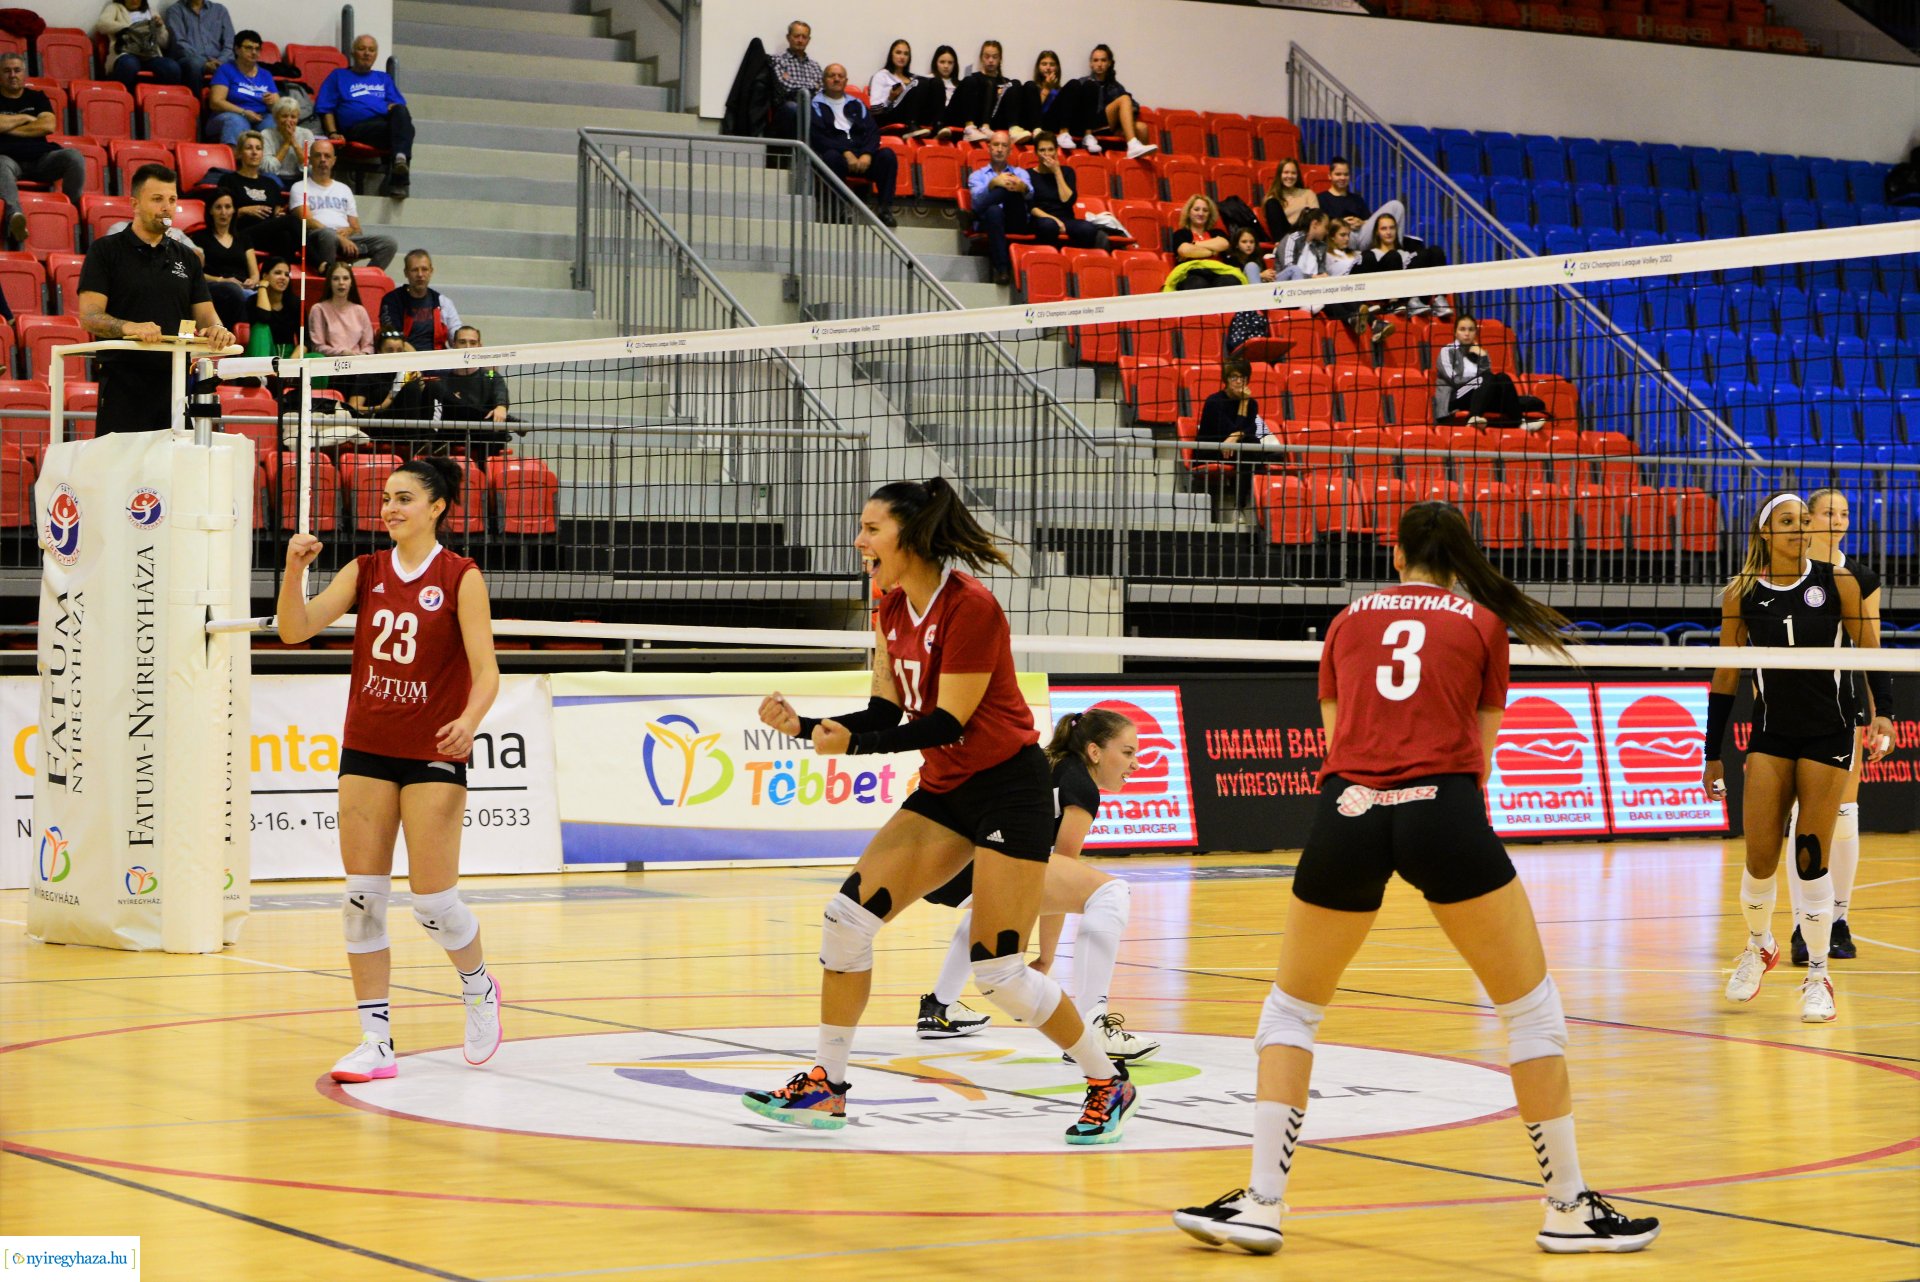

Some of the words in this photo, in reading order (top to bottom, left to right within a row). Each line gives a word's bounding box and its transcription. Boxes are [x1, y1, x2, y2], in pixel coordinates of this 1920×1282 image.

[1592, 259, 1620, 270] Champions
[1622, 258, 1641, 267] League
[1642, 256, 1658, 265] Volley
[1348, 593, 1474, 620] NYÍREGYHÁZA
[372, 608, 419, 665] 23
[1783, 614, 1796, 646] 1
[1376, 619, 1427, 701] 3
[46, 592, 69, 794] FATUM
[894, 658, 923, 712] 17
[1205, 729, 1283, 760] UMAMI
[745, 758, 896, 806] Többet
[1216, 767, 1322, 797] NYÍREGYHÁZ
[1861, 761, 1912, 783] UNYADI
[1096, 795, 1181, 820] mami
[1499, 787, 1594, 811] umami
[478, 808, 530, 826] 0533
[1123, 823, 1178, 834] BURGER
[1506, 814, 1532, 824] BAR
[1543, 813, 1592, 824] BURGER
[1629, 812, 1654, 821] BAR
[1665, 810, 1712, 820] BURGER
